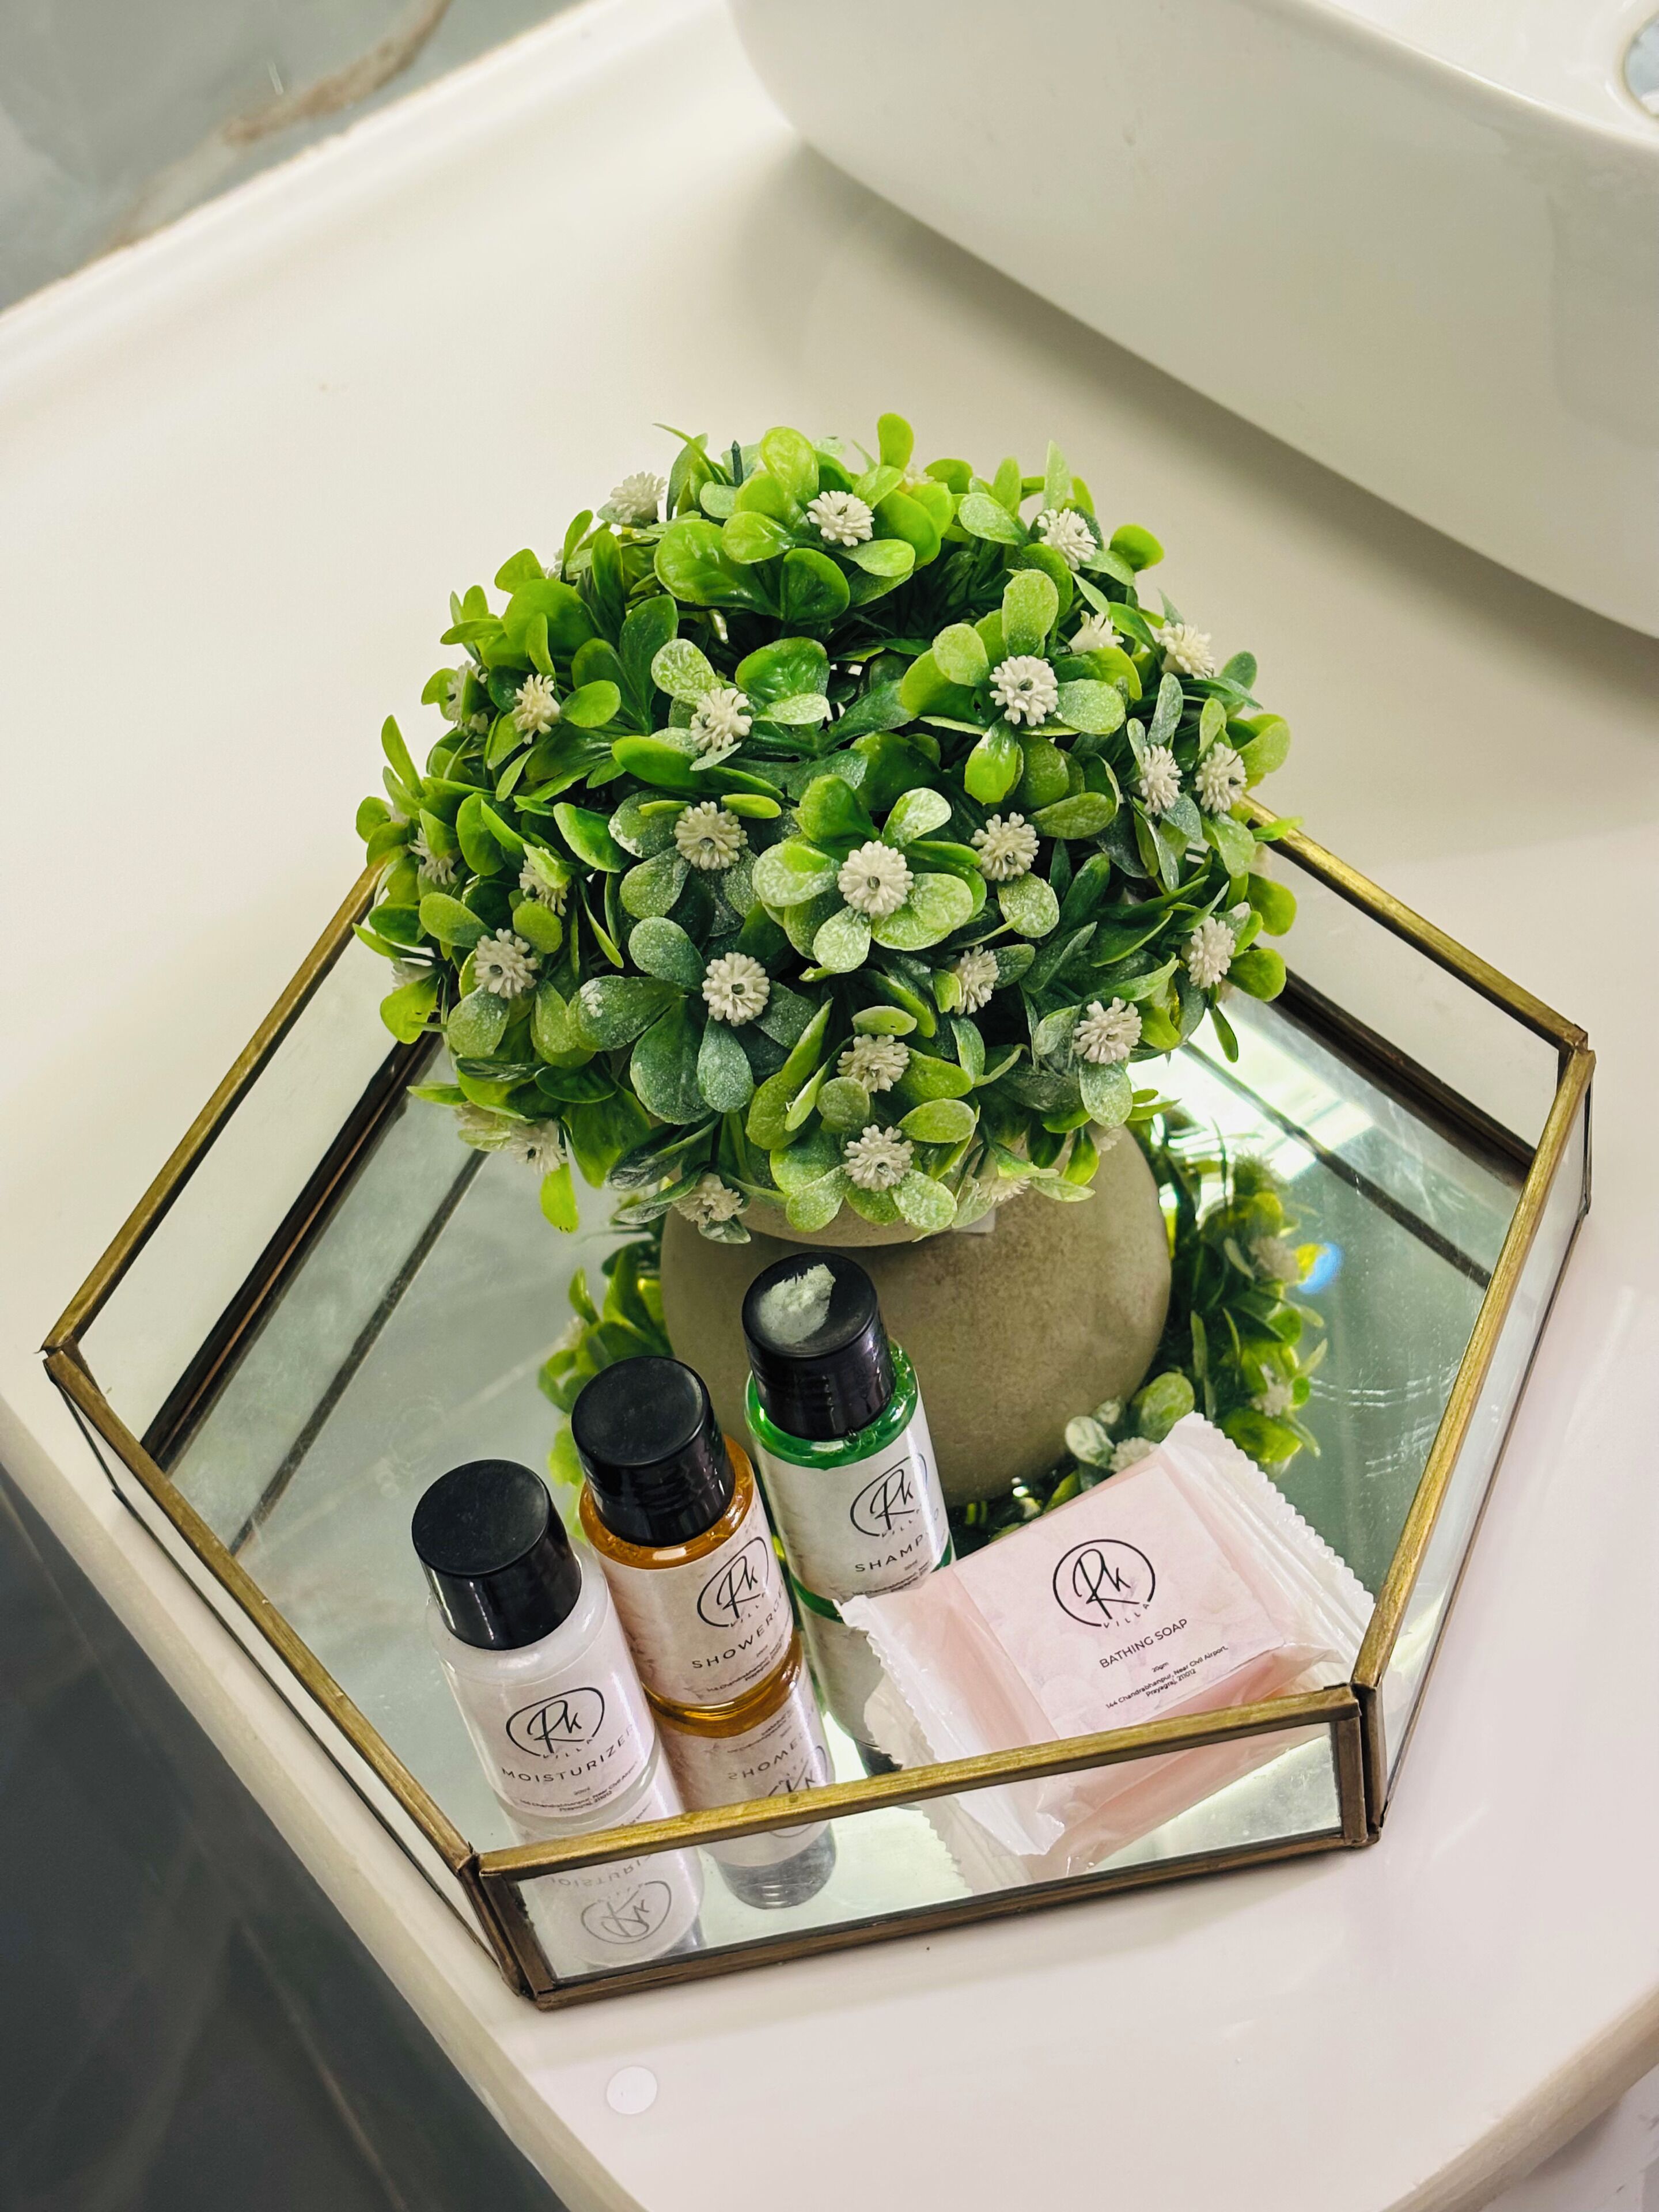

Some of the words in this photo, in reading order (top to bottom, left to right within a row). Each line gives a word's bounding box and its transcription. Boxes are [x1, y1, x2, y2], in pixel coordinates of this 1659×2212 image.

[1104, 1603, 1150, 1629] VILLA
[1099, 1636, 1154, 1668] BATHING
[1154, 1618, 1188, 1641] SOAP
[1105, 1700, 1118, 1709] 144
[1173, 1665, 1188, 1676] Near
[1189, 1656, 1203, 1667] Civil
[1177, 1668, 1196, 1682] 211012
